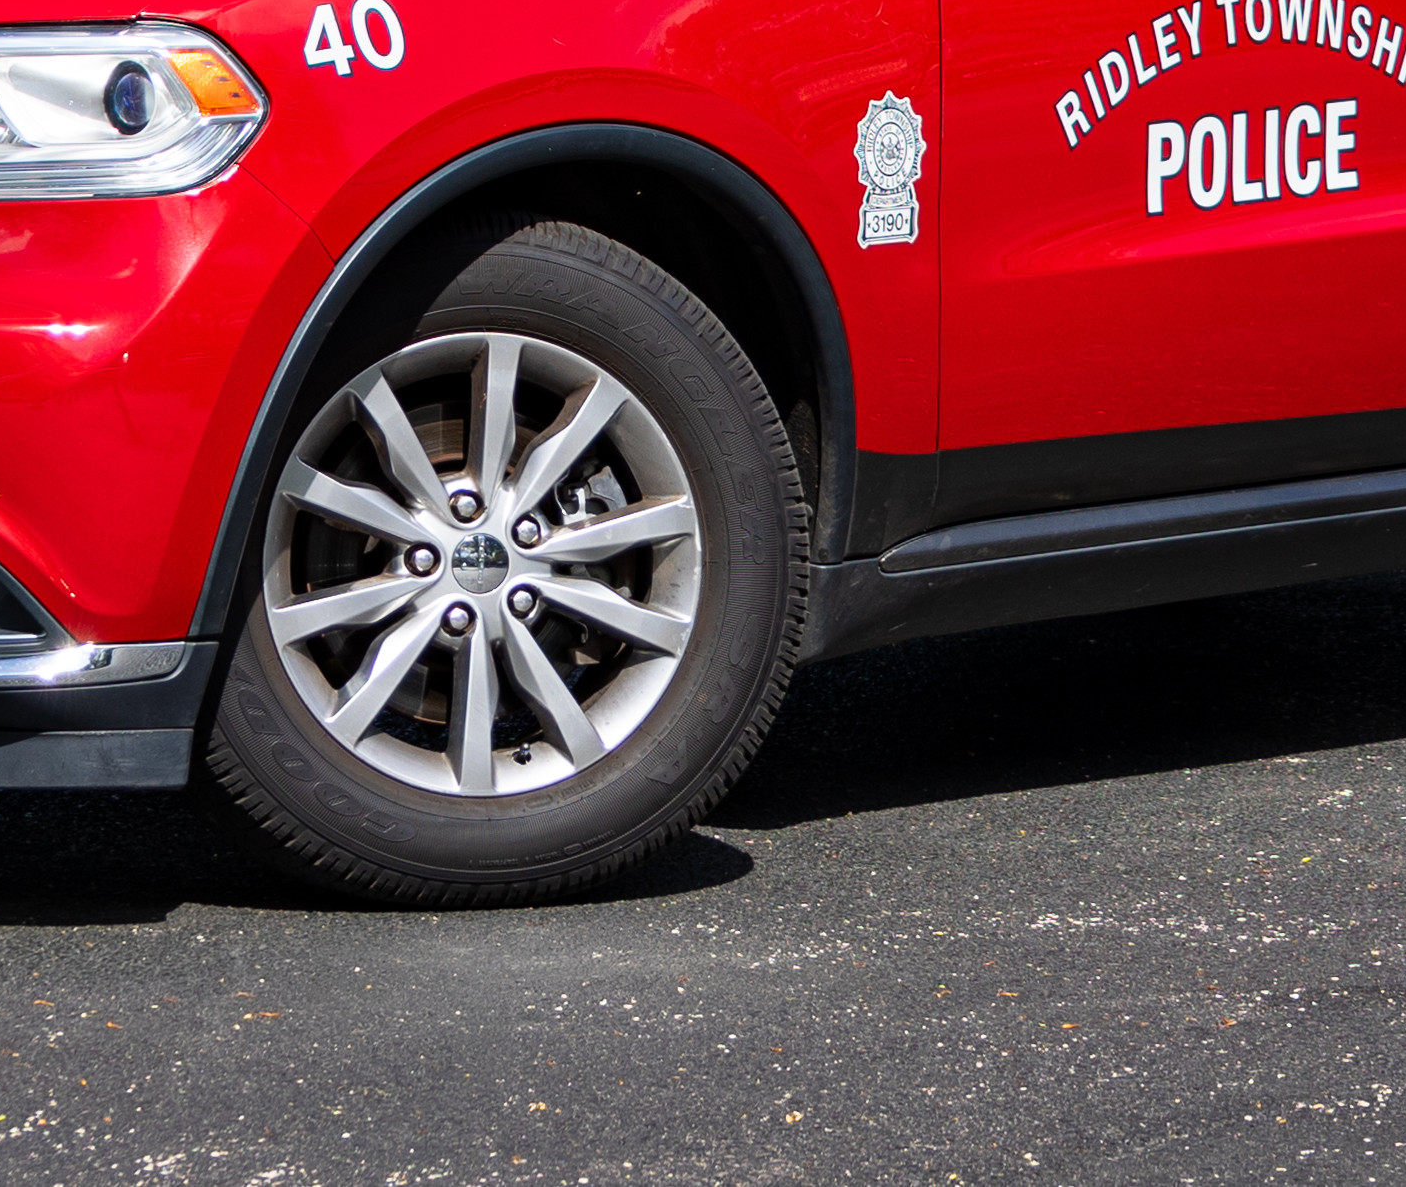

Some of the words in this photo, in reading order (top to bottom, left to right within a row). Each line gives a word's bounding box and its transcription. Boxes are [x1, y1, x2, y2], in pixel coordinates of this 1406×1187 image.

[1054, 0, 1202, 150] RIDLEY
[873, 167, 906, 188] POLICE
[1146, 97, 1360, 216] POLICE
[872, 213, 904, 233] 3190
